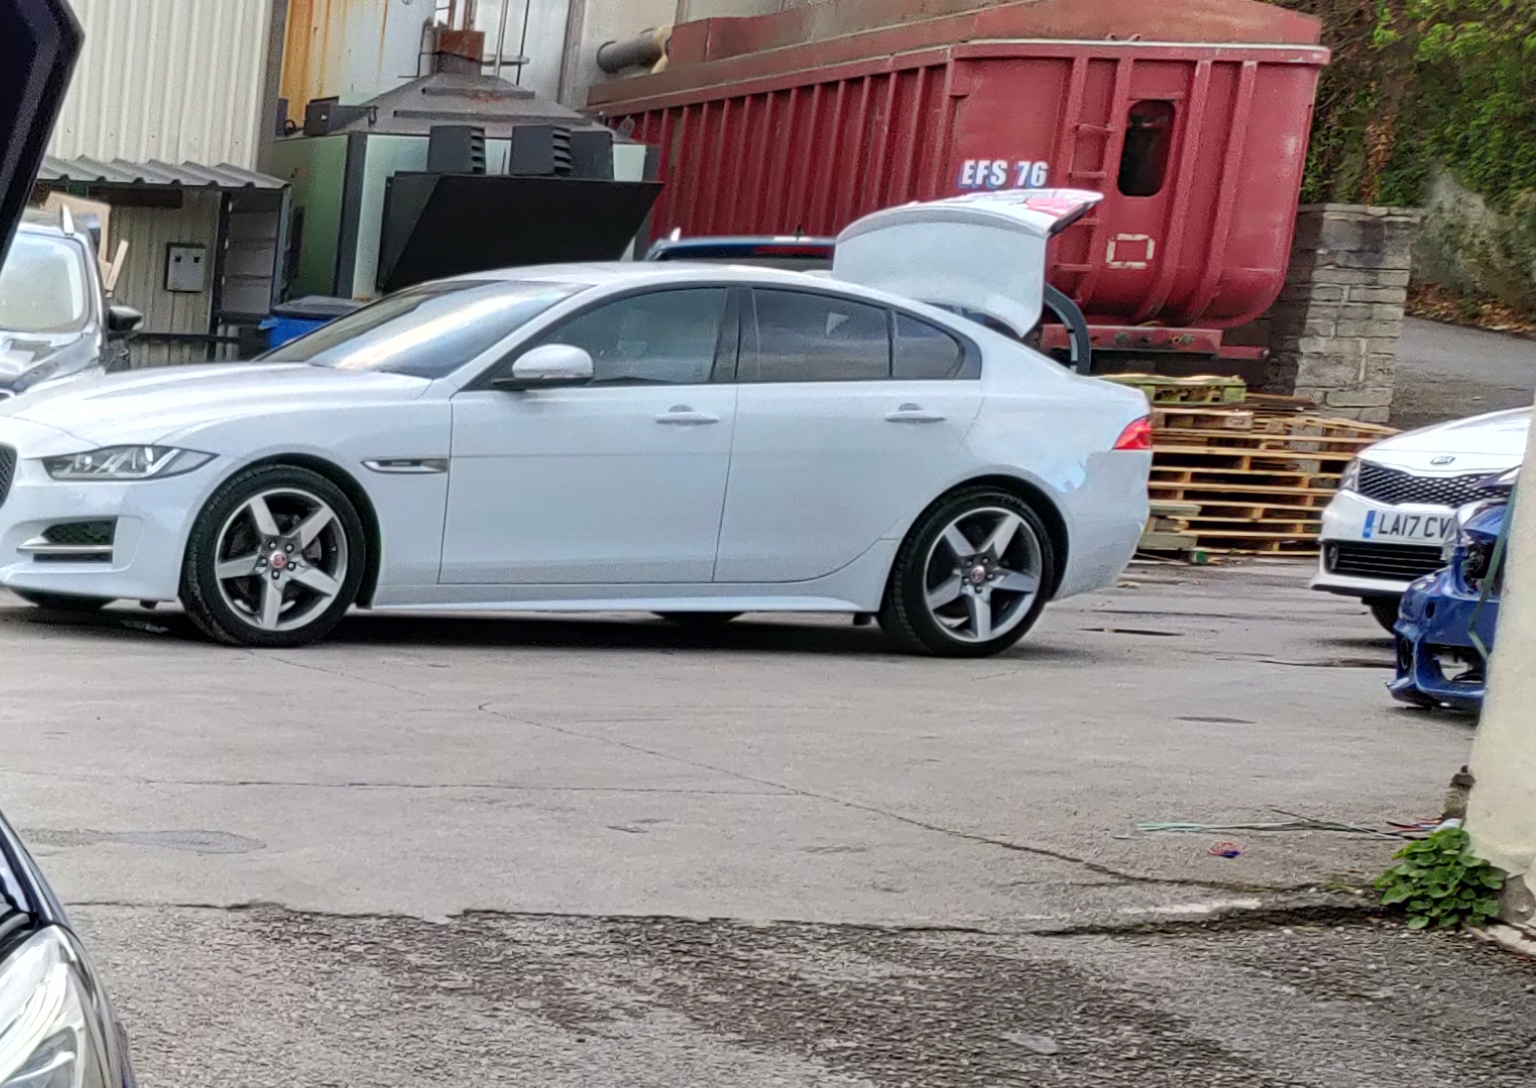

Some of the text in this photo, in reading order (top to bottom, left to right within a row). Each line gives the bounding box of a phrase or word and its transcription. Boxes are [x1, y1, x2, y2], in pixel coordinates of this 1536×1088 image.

[959, 160, 1048, 187] EFS 76
[1378, 514, 1452, 538] LA17 CV
